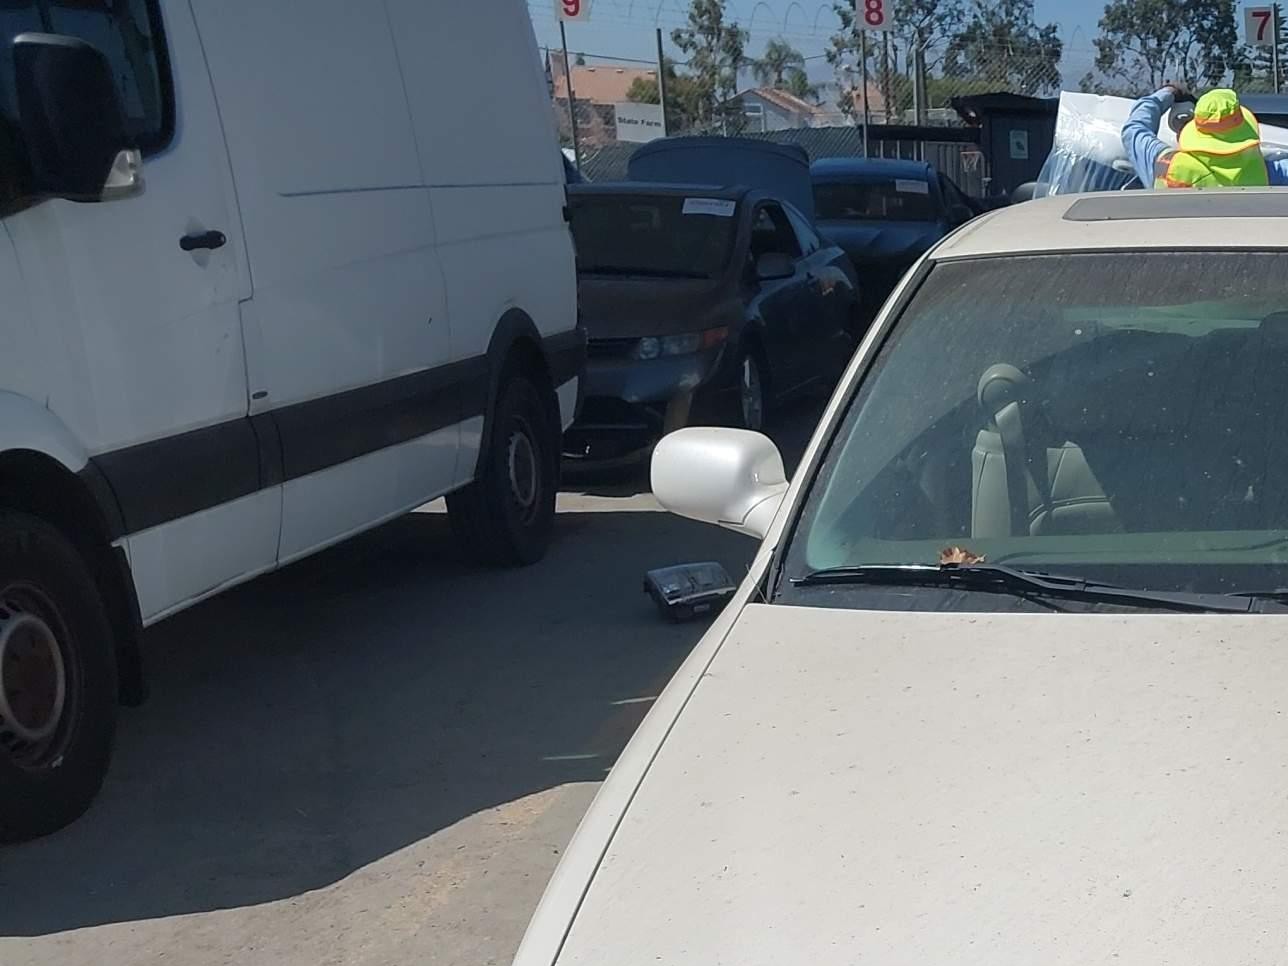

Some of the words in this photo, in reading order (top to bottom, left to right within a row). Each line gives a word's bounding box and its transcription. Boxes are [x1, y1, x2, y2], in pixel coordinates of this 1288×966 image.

[563, 0, 580, 16] 9
[865, 0, 884, 26] 8
[1251, 11, 1271, 41] 7
[617, 116, 639, 125] State
[640, 119, 662, 128] Farm
